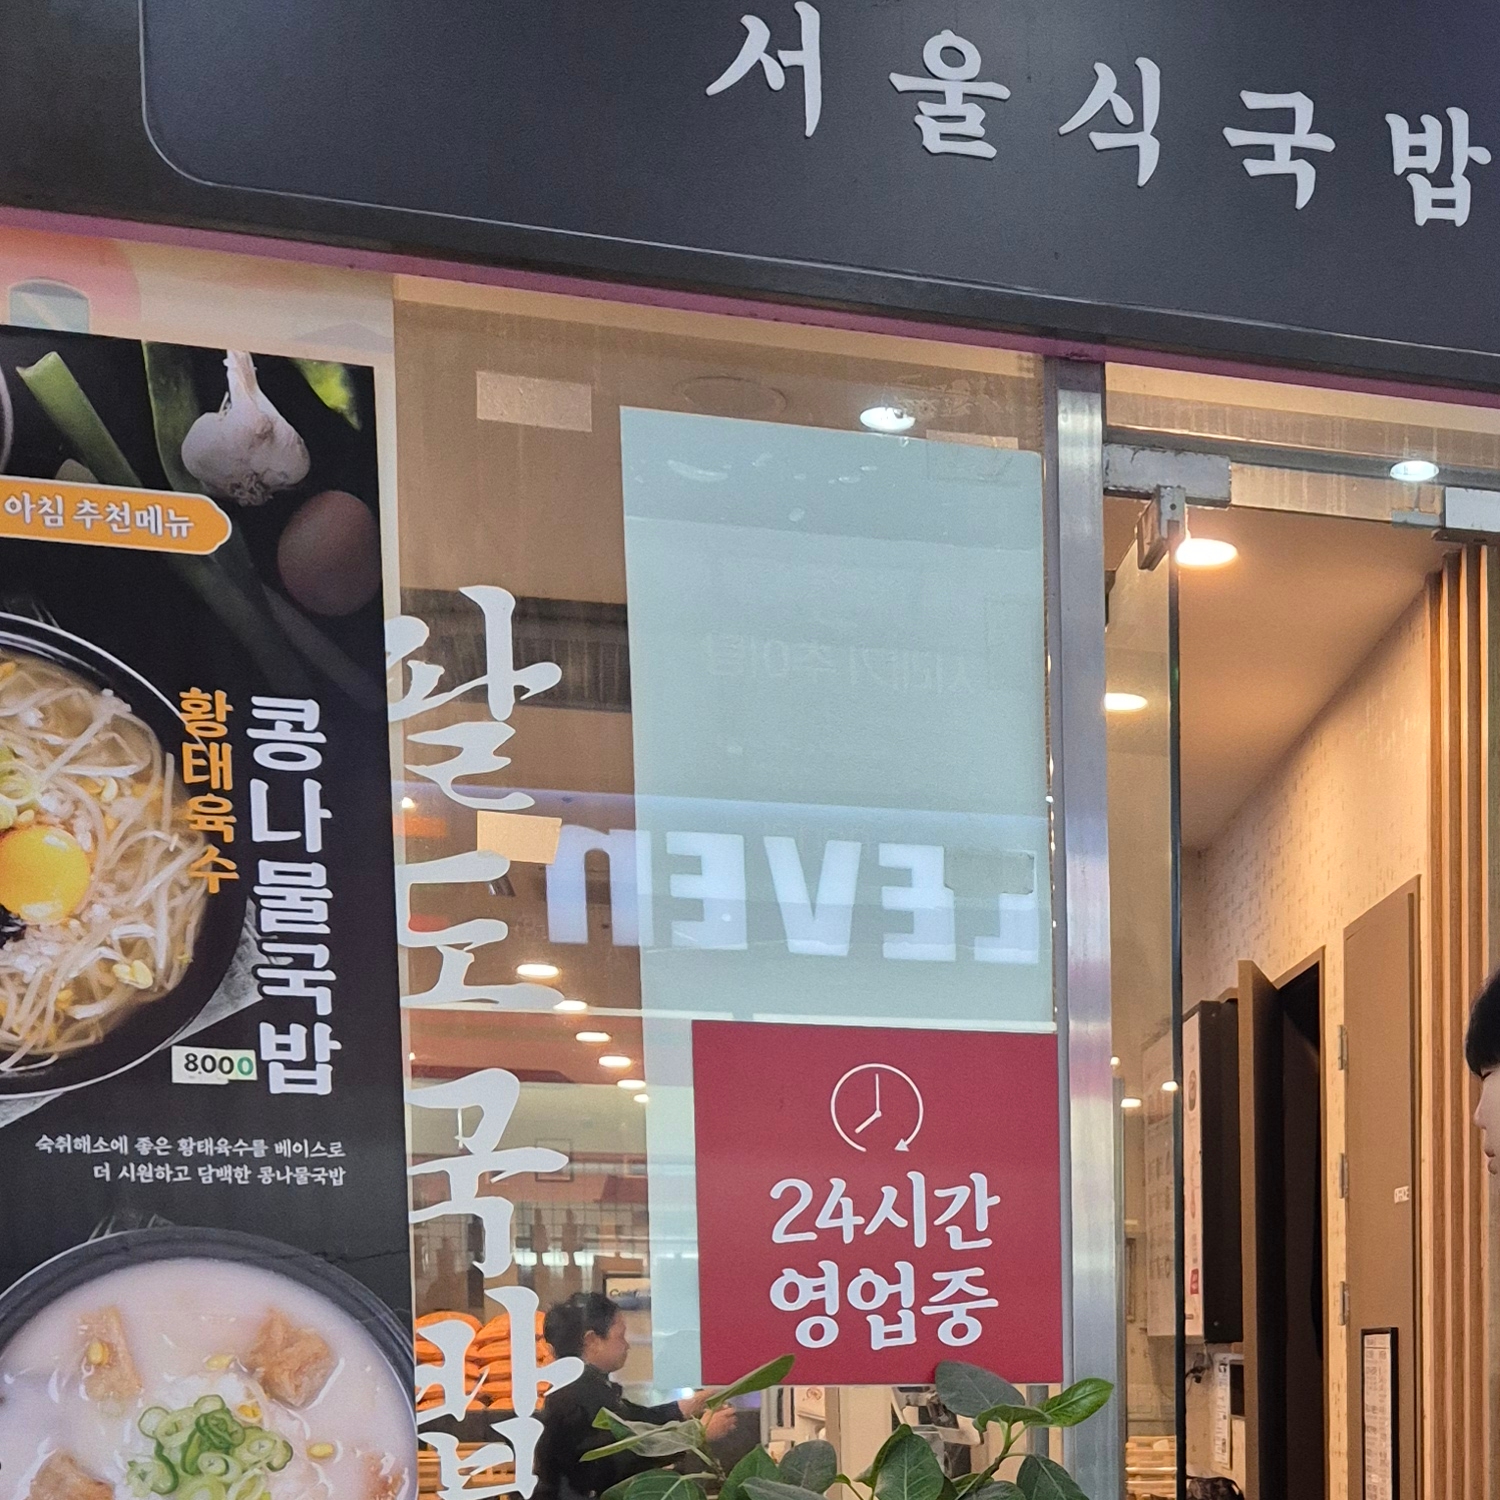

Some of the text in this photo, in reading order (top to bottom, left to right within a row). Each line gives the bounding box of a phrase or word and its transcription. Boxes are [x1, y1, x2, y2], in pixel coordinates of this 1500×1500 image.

[5, 492, 195, 538] 아침 추천메뉴
[179, 687, 240, 894] 황태육수
[246, 695, 342, 1096] 콩나물국밥
[35, 1134, 346, 1158] 숙취해소에 좋은 황태육수를 베이스로
[93, 1162, 346, 1187] 더 시원하고 담백한 콩나물국밥
[769, 1171, 1000, 1251] 24시간
[769, 1260, 999, 1351] 영업중
